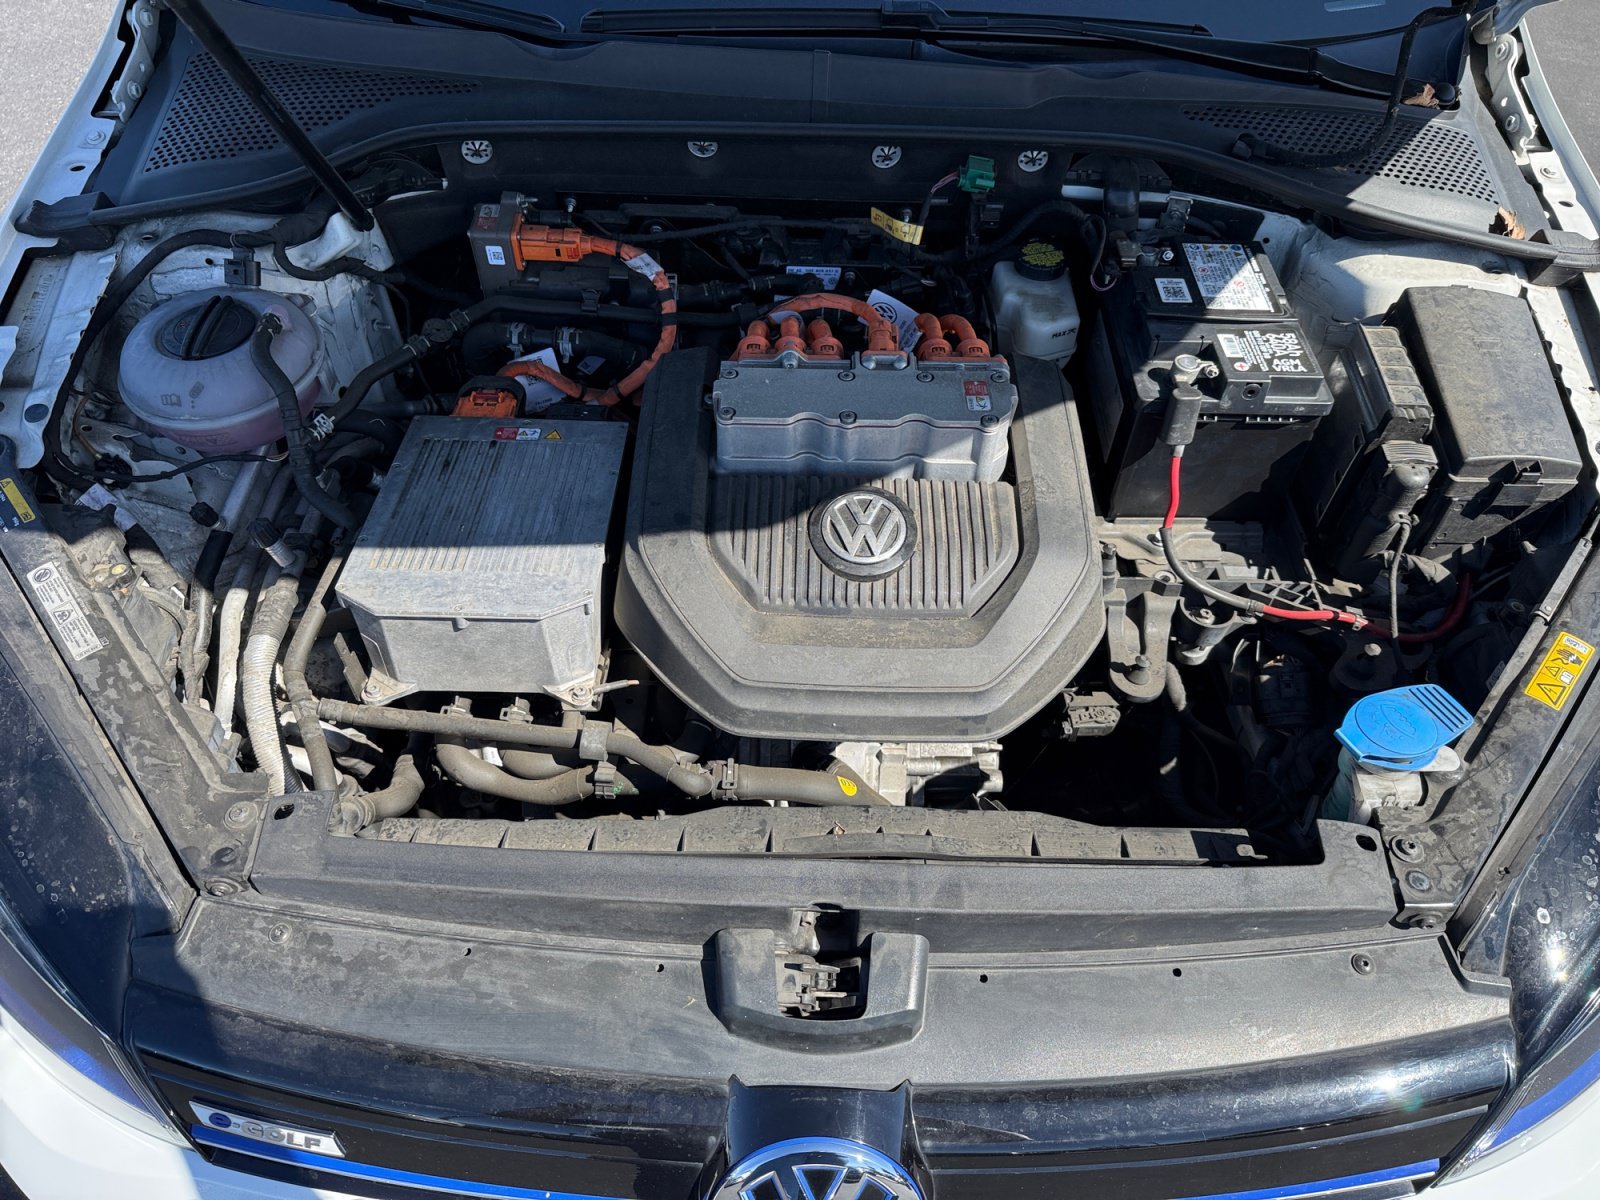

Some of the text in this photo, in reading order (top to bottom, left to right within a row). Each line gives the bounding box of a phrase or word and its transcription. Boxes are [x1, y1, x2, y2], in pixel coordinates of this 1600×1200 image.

[1280, 333, 1304, 356] 58Ah
[1273, 358, 1301, 367] AGM
[821, 491, 907, 565] VW
[209, 1112, 321, 1148] e-GOLF
